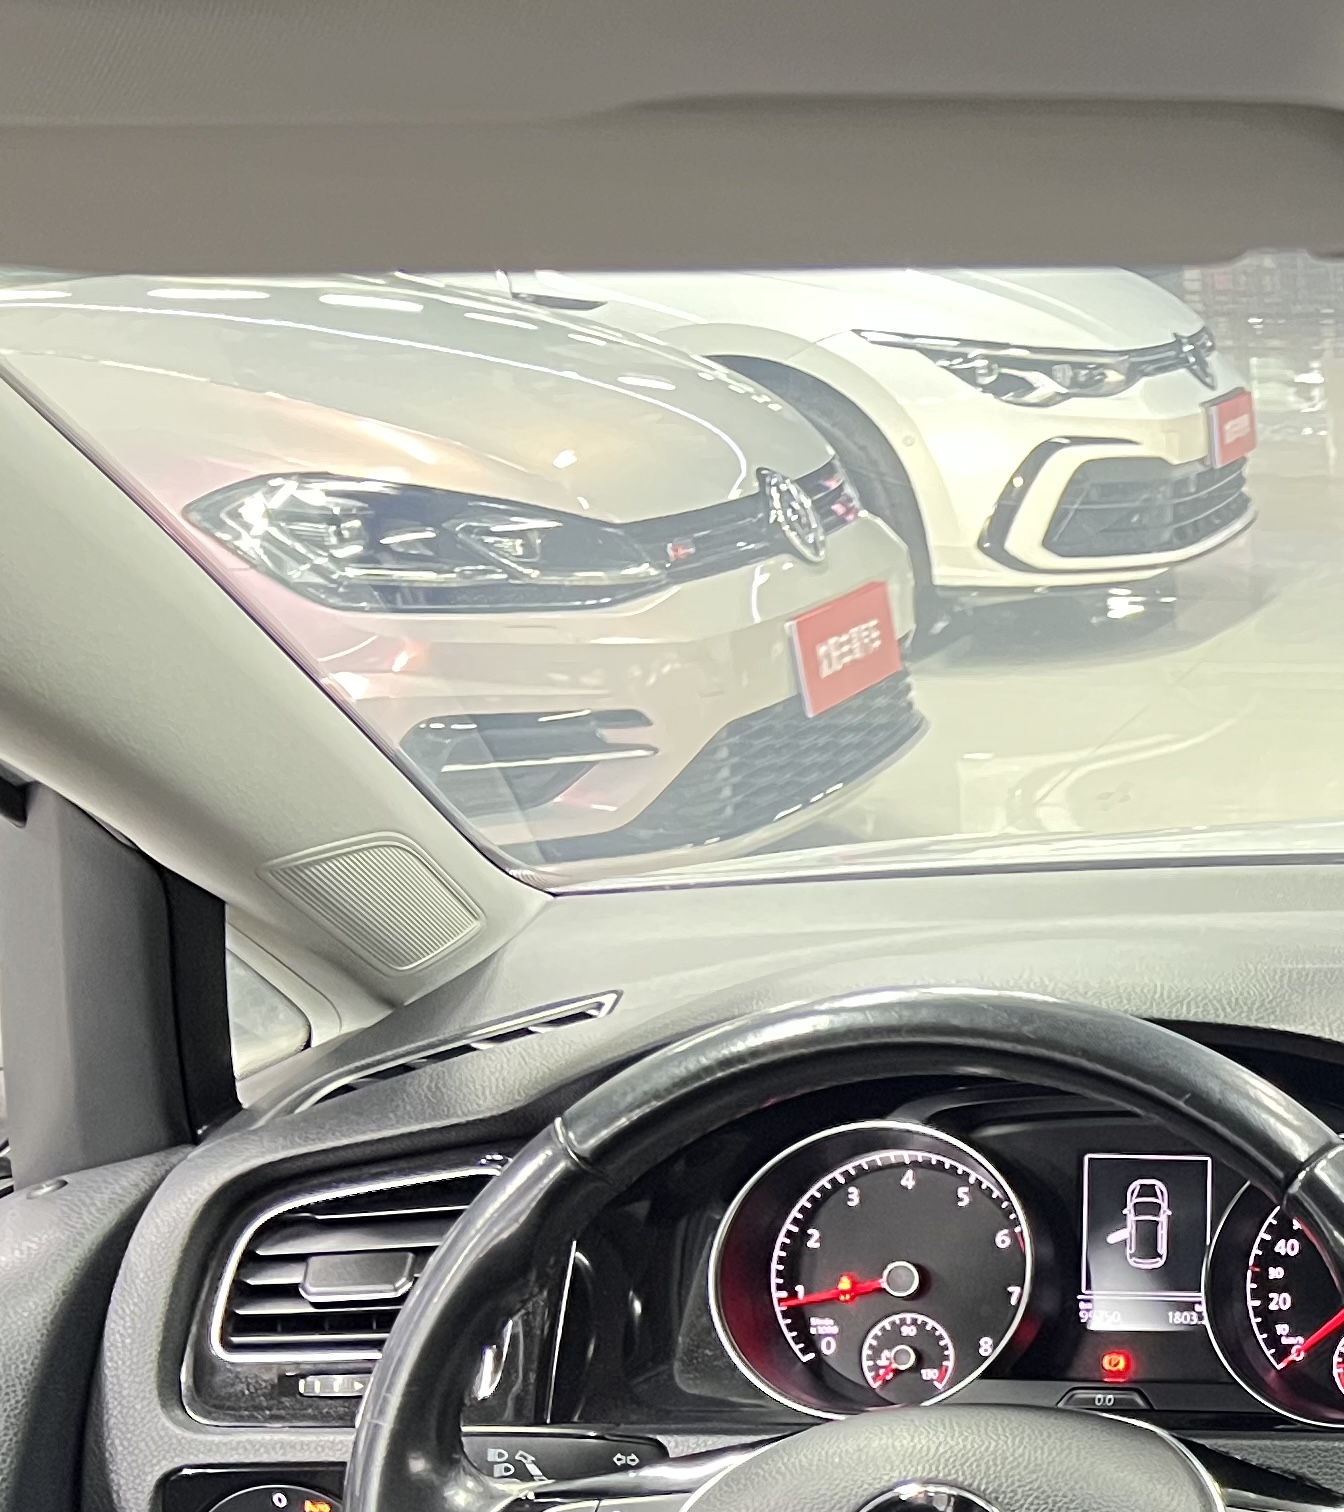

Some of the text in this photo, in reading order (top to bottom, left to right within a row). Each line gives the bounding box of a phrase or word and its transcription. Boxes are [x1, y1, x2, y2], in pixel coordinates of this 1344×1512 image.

[900, 1169, 916, 1190] 4
[847, 1187, 860, 1207] 3
[957, 1187, 970, 1207] 5
[806, 1228, 821, 1248] 2
[995, 1229, 1011, 1248] 6
[1274, 1238, 1300, 1257] 40
[1007, 1286, 1021, 1305] 7
[1268, 1292, 1292, 1311] 20
[820, 1336, 836, 1355] 0
[978, 1336, 993, 1356] 8
